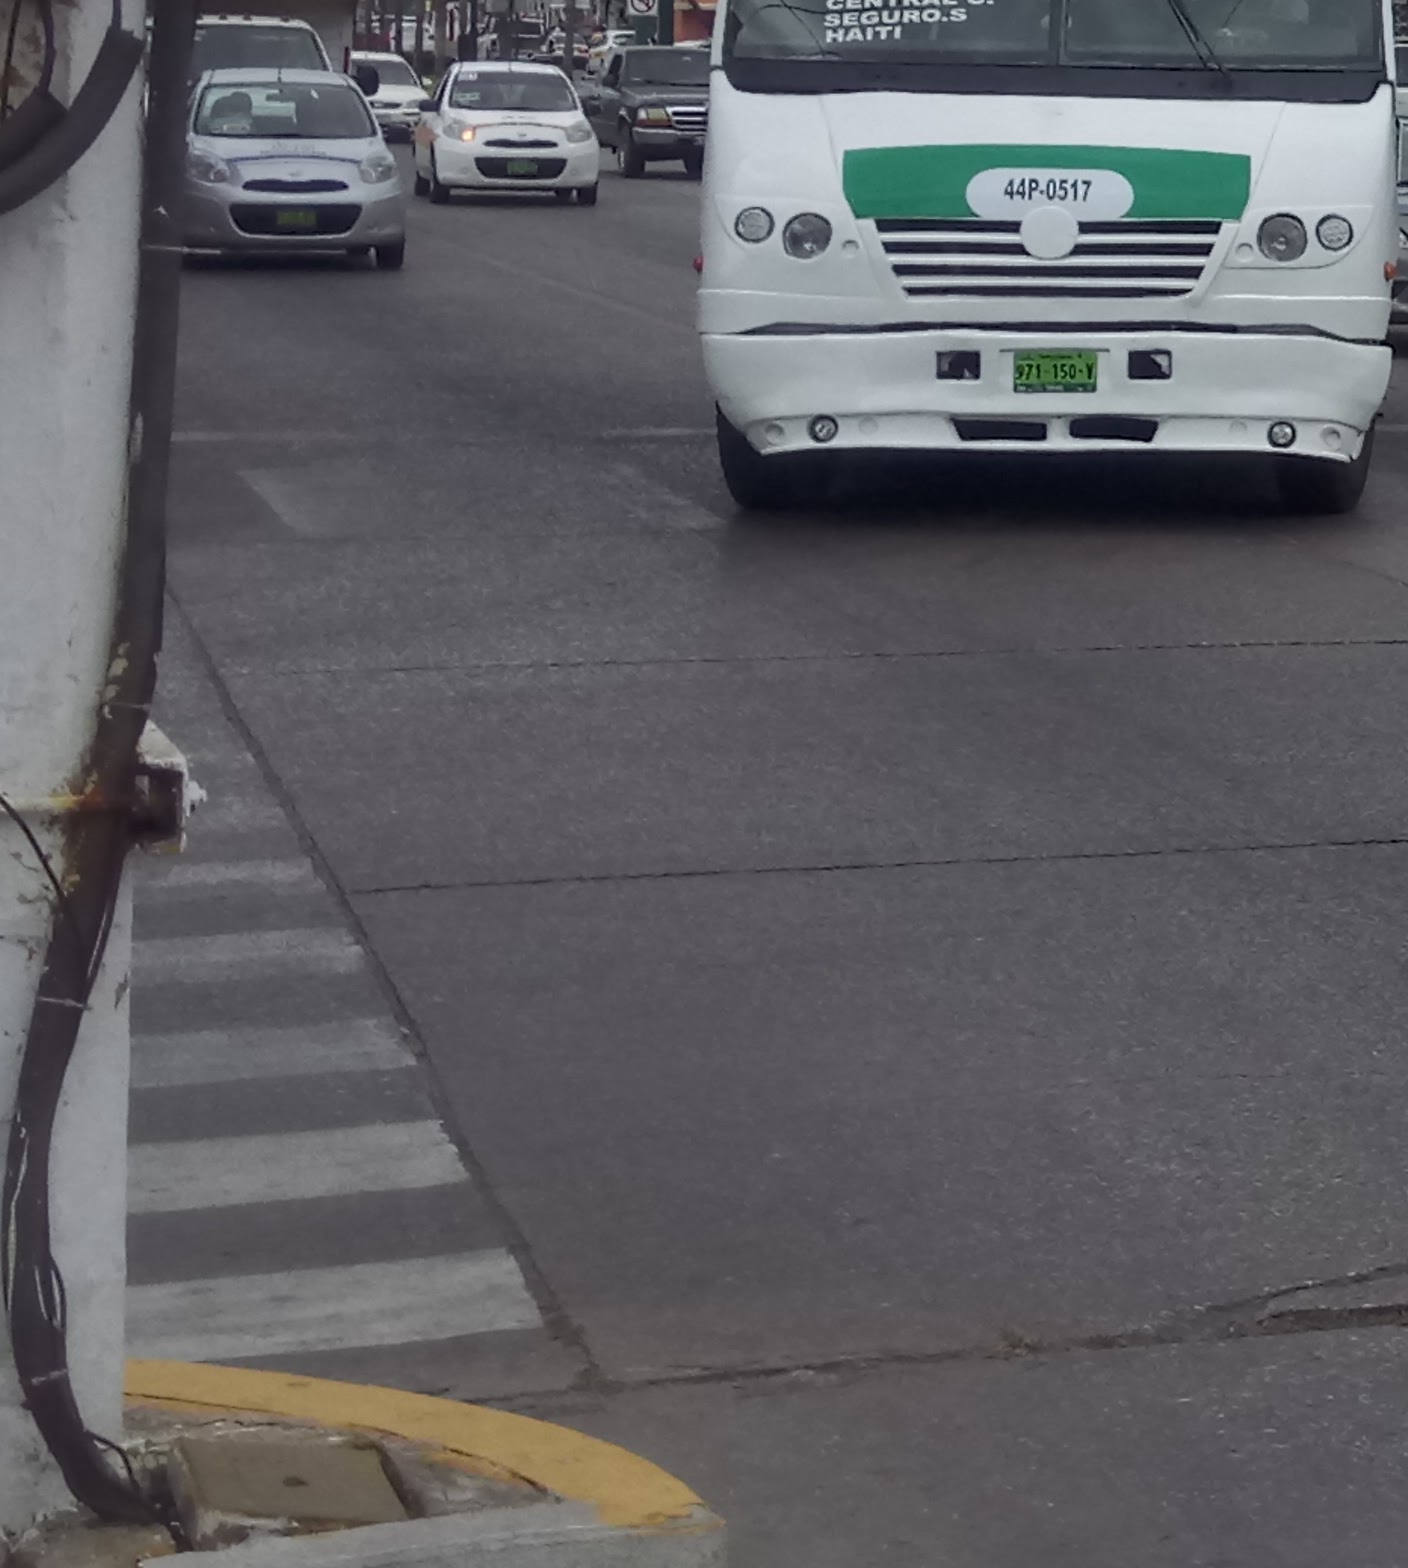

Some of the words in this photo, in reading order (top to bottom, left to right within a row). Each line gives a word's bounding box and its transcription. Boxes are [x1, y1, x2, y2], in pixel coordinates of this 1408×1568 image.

[823, 8, 968, 28] SEGURO.S
[825, 26, 903, 44] HAITI
[1003, 177, 1093, 203] 44P-0517
